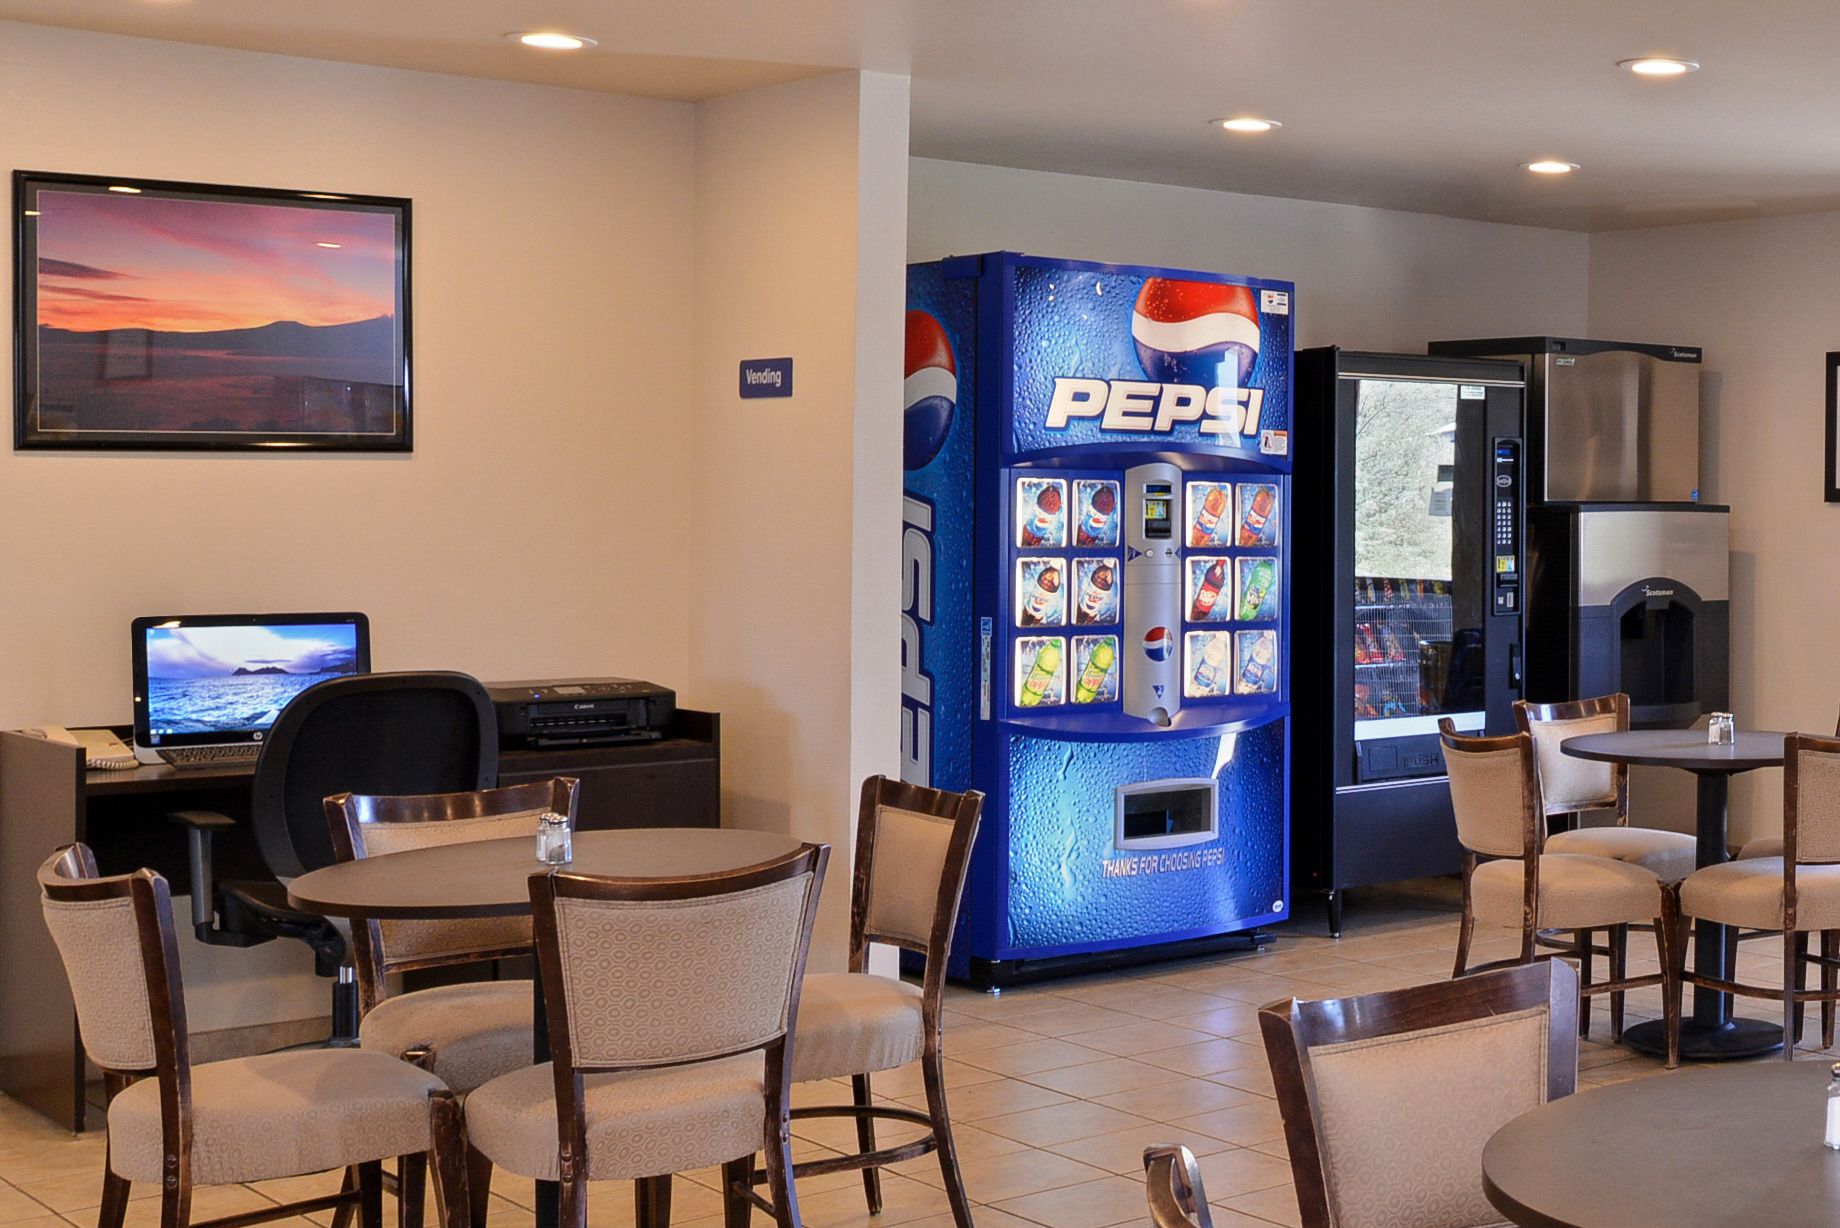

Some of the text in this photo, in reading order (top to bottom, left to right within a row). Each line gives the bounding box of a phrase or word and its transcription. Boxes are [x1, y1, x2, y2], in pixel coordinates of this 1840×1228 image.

[746, 368, 782, 387] Vending
[1045, 378, 1264, 435] PEPSI
[900, 495, 932, 788] EPSI
[1103, 847, 1225, 878] THANKS FOR CHOOSING PEPSI
